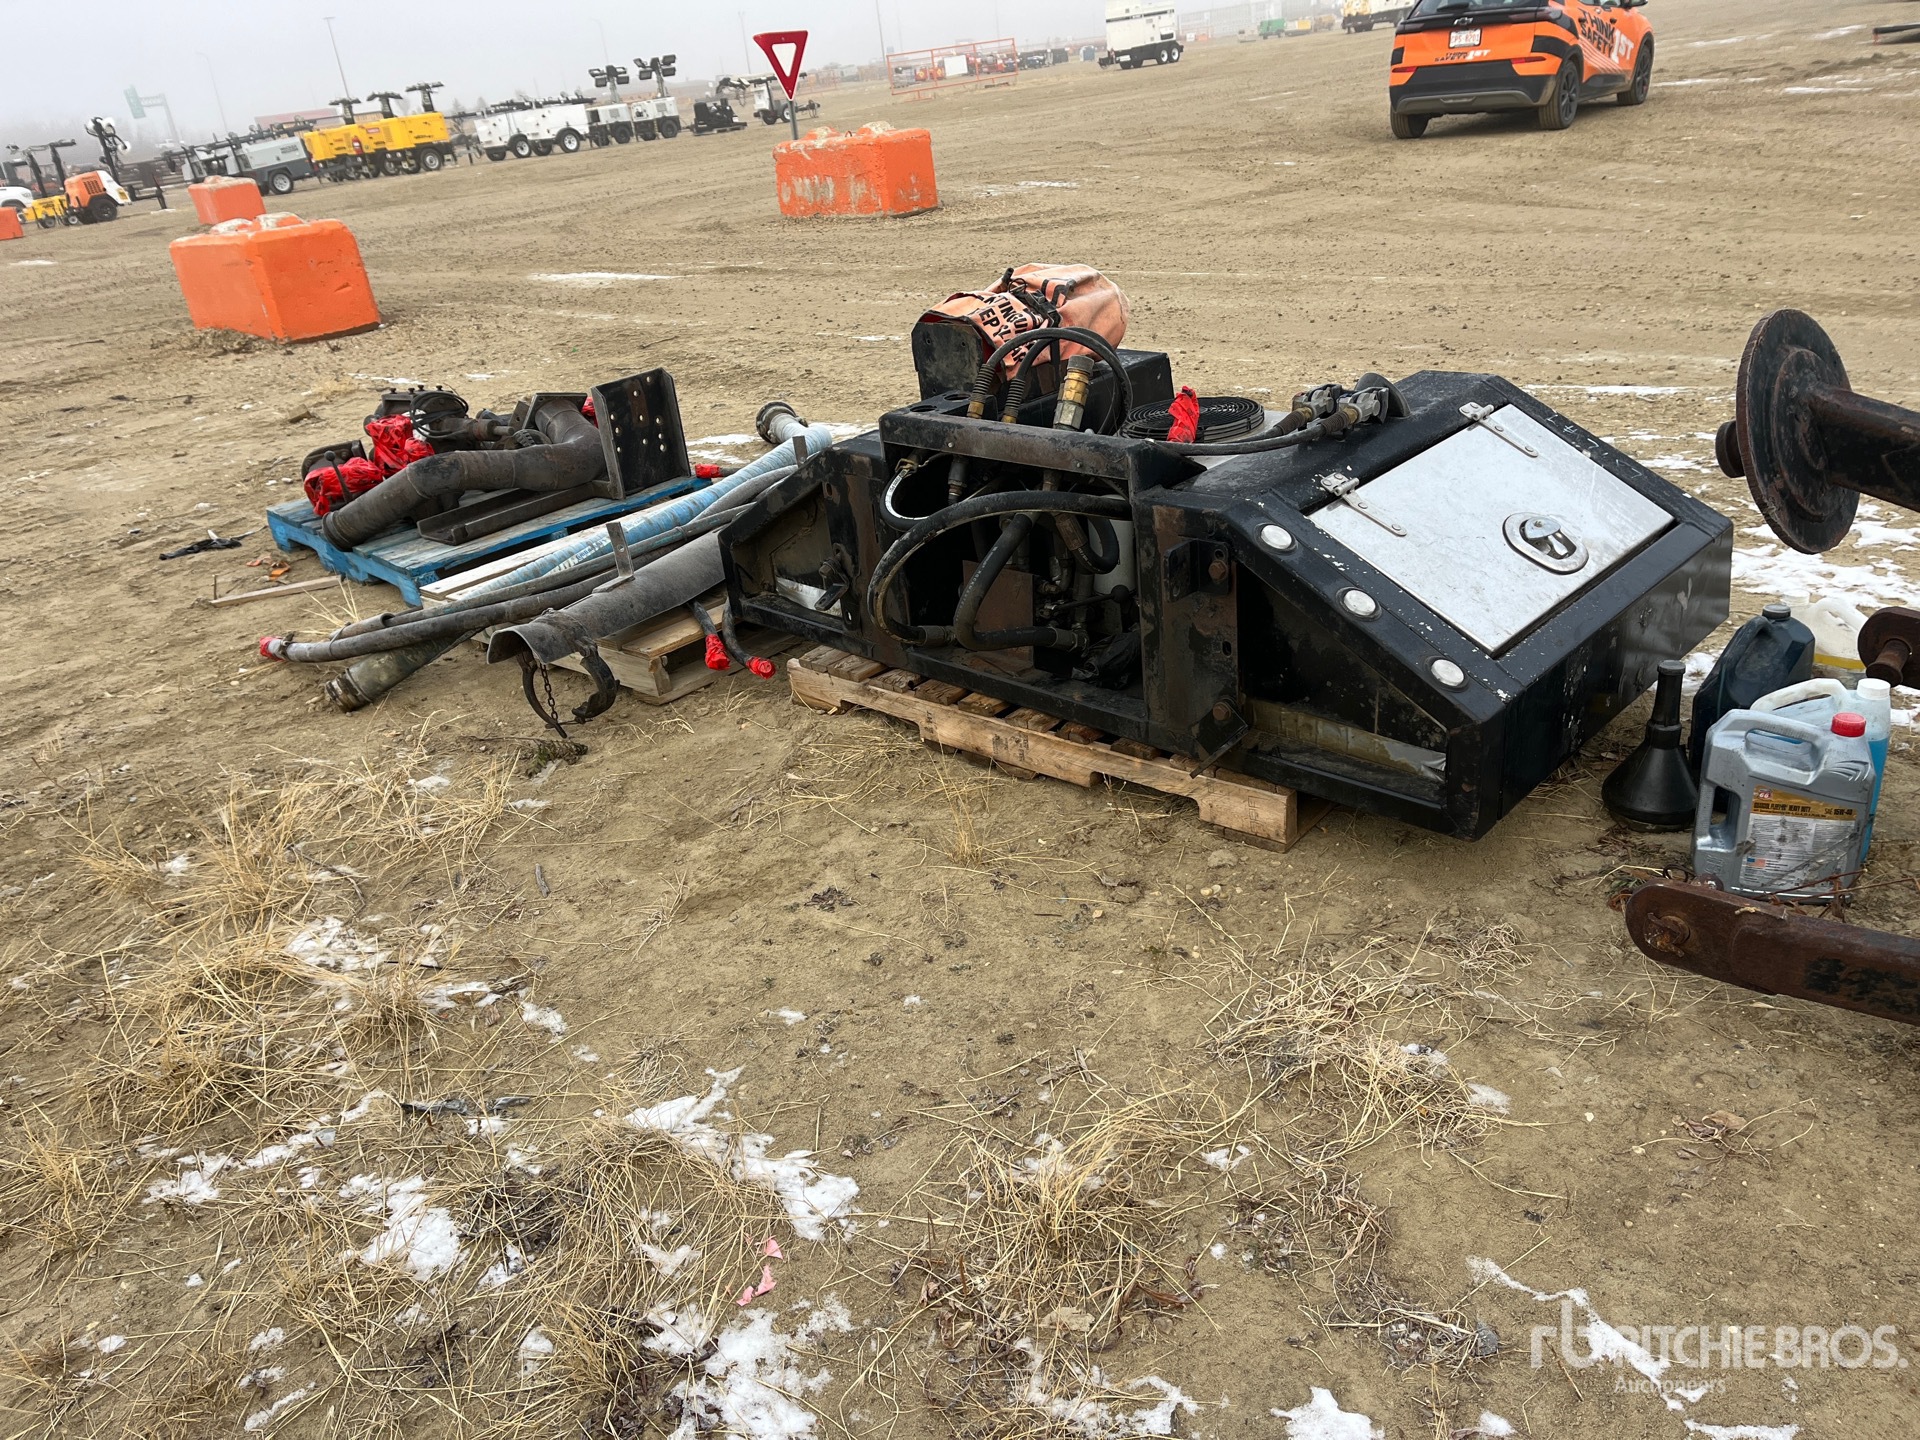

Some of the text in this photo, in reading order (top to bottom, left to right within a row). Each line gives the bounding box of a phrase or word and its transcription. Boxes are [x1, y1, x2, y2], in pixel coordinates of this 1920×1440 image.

[1577, 7, 1615, 44] THINK
[1580, 22, 1634, 64] SAFETY 1ST
